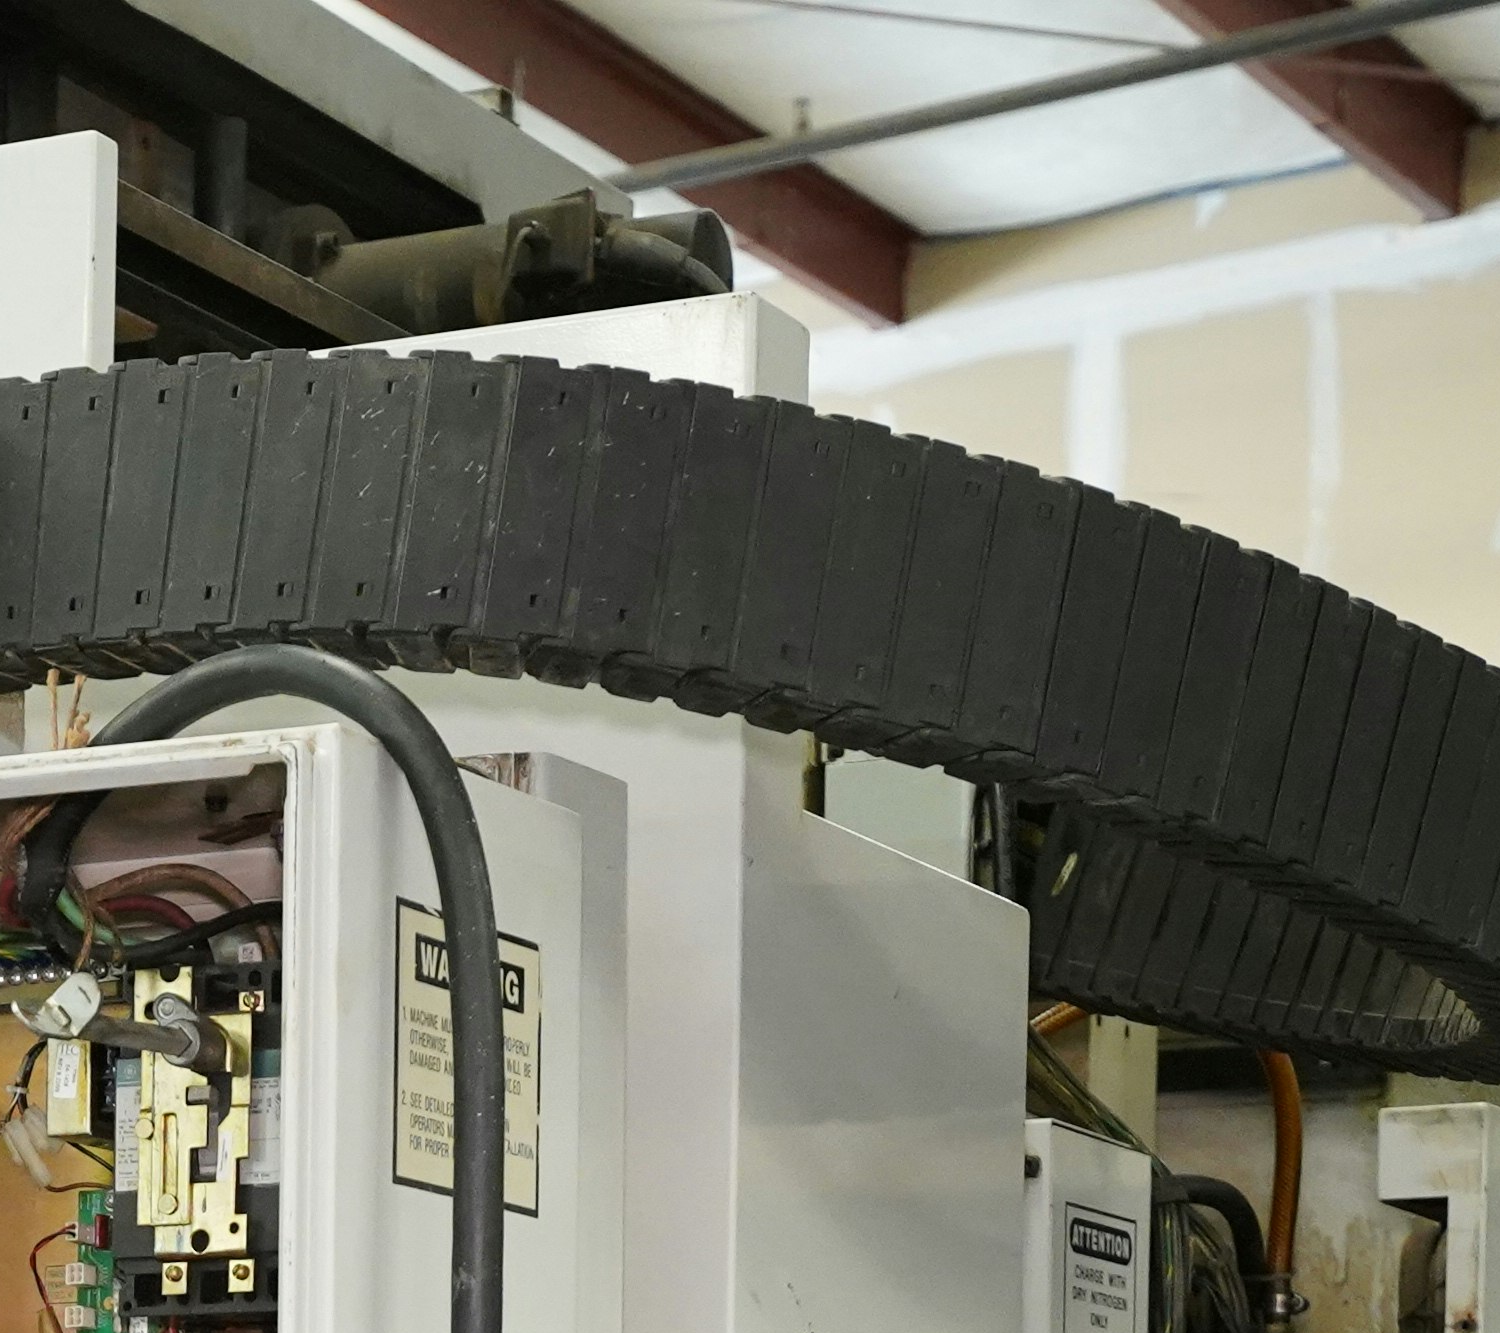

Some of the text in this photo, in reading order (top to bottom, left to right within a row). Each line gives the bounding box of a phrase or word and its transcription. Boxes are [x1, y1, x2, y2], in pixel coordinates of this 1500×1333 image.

[410, 1007, 438, 1030] MACHINE
[410, 1049, 441, 1072] DAMAGED
[524, 1063, 532, 1078] BE
[410, 1092, 422, 1109] SEE
[410, 1113, 445, 1137] OPERATORS
[409, 1134, 449, 1157] FOR PROPER
[1072, 1223, 1130, 1260] ATTENTION
